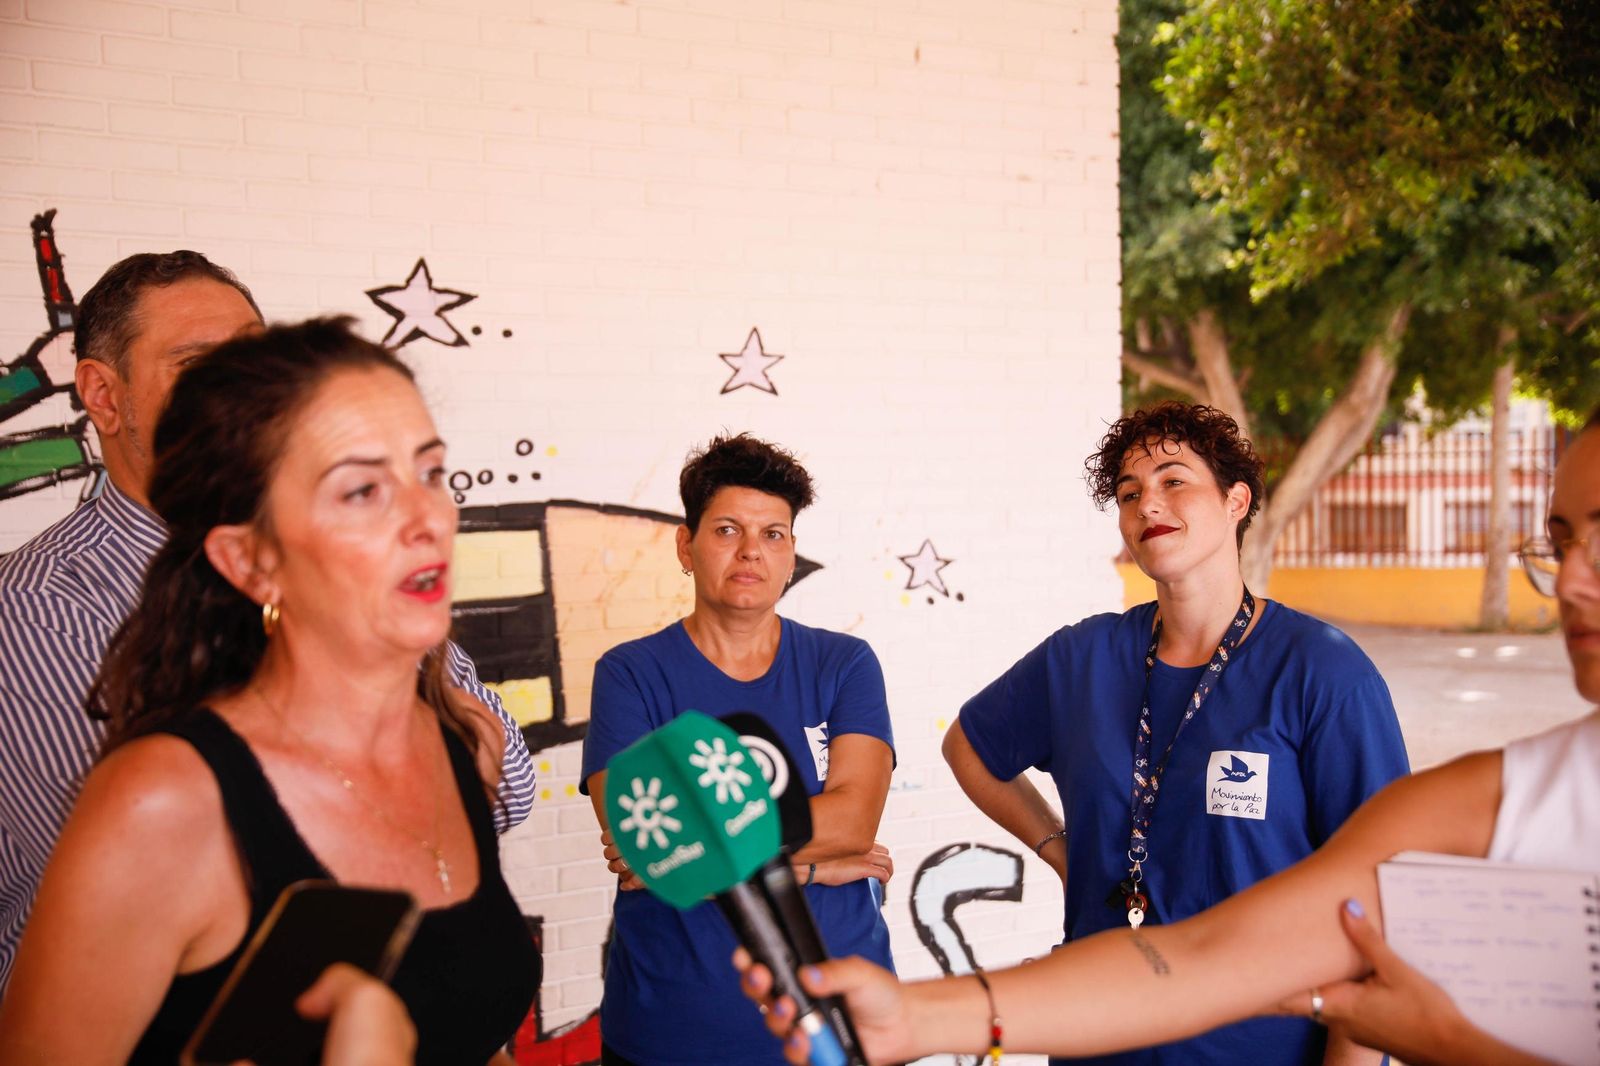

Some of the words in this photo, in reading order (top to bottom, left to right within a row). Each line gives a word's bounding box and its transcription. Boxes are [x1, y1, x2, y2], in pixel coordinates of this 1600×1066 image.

[1211, 787, 1262, 802] Movimiento
[1212, 802, 1230, 812] por
[1231, 802, 1239, 812] la
[1244, 802, 1260, 814] Paz
